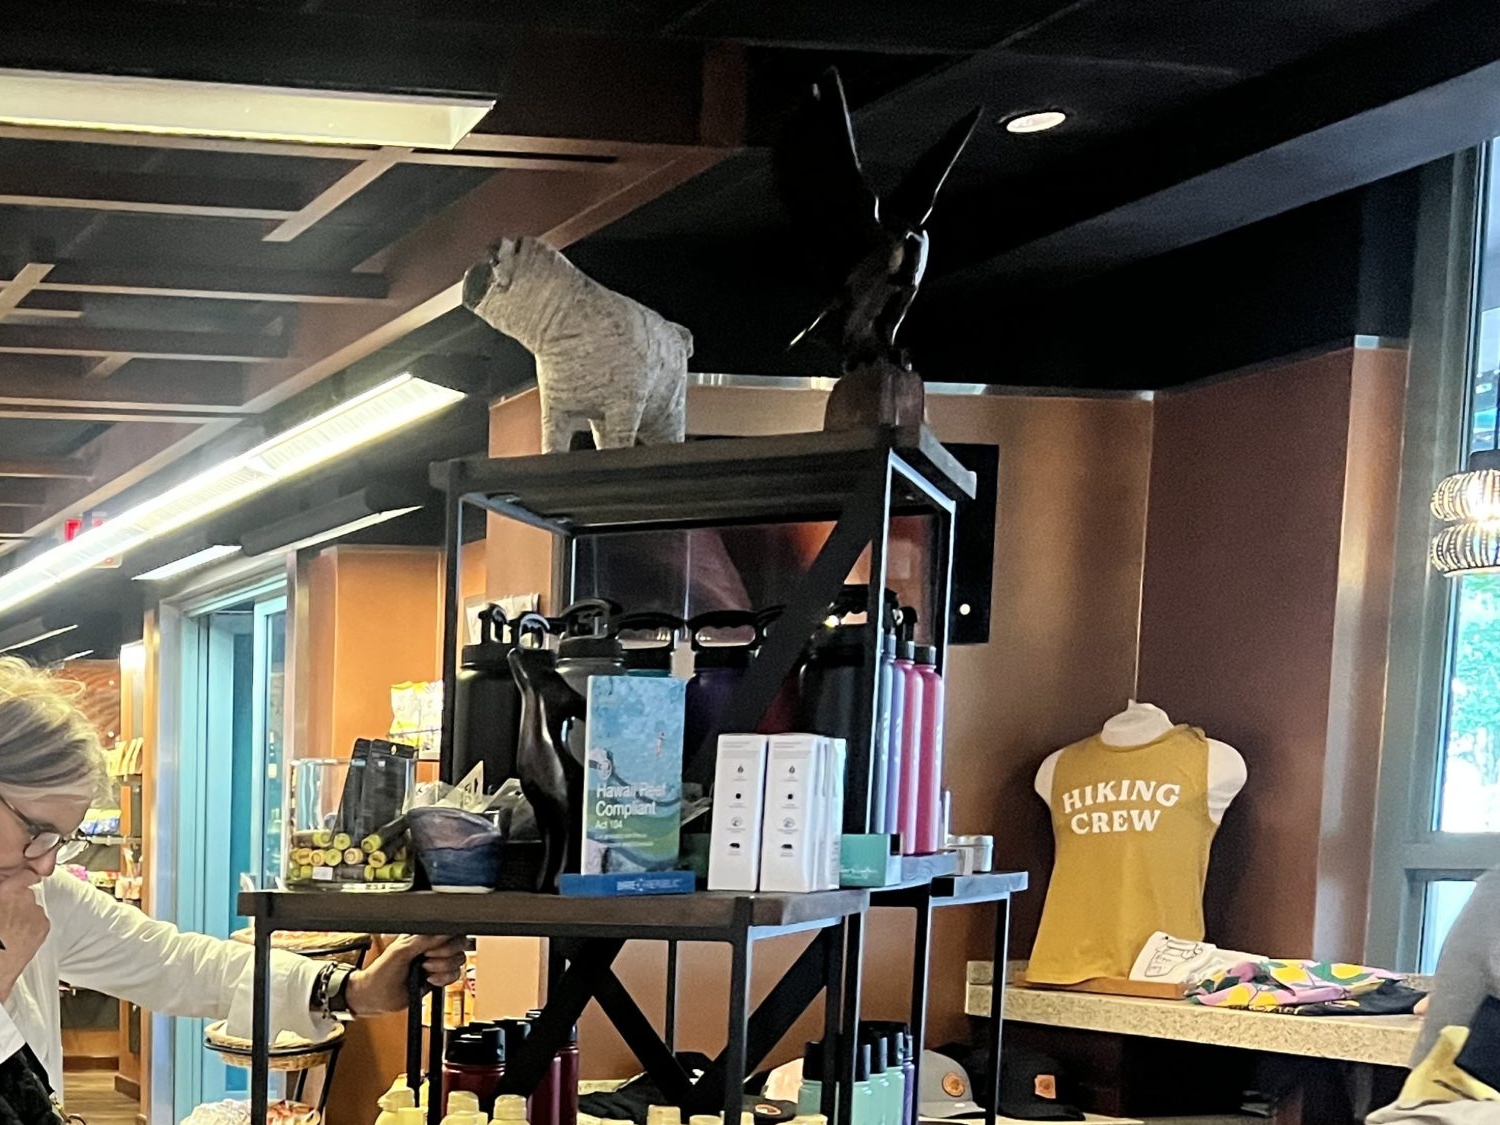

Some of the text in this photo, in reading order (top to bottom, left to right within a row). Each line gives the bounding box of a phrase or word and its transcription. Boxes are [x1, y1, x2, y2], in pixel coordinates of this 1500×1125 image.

[596, 783, 637, 798] Hawaii
[1062, 779, 1180, 814] HIKING
[595, 800, 656, 819] Compliant
[1071, 809, 1161, 835] CREW
